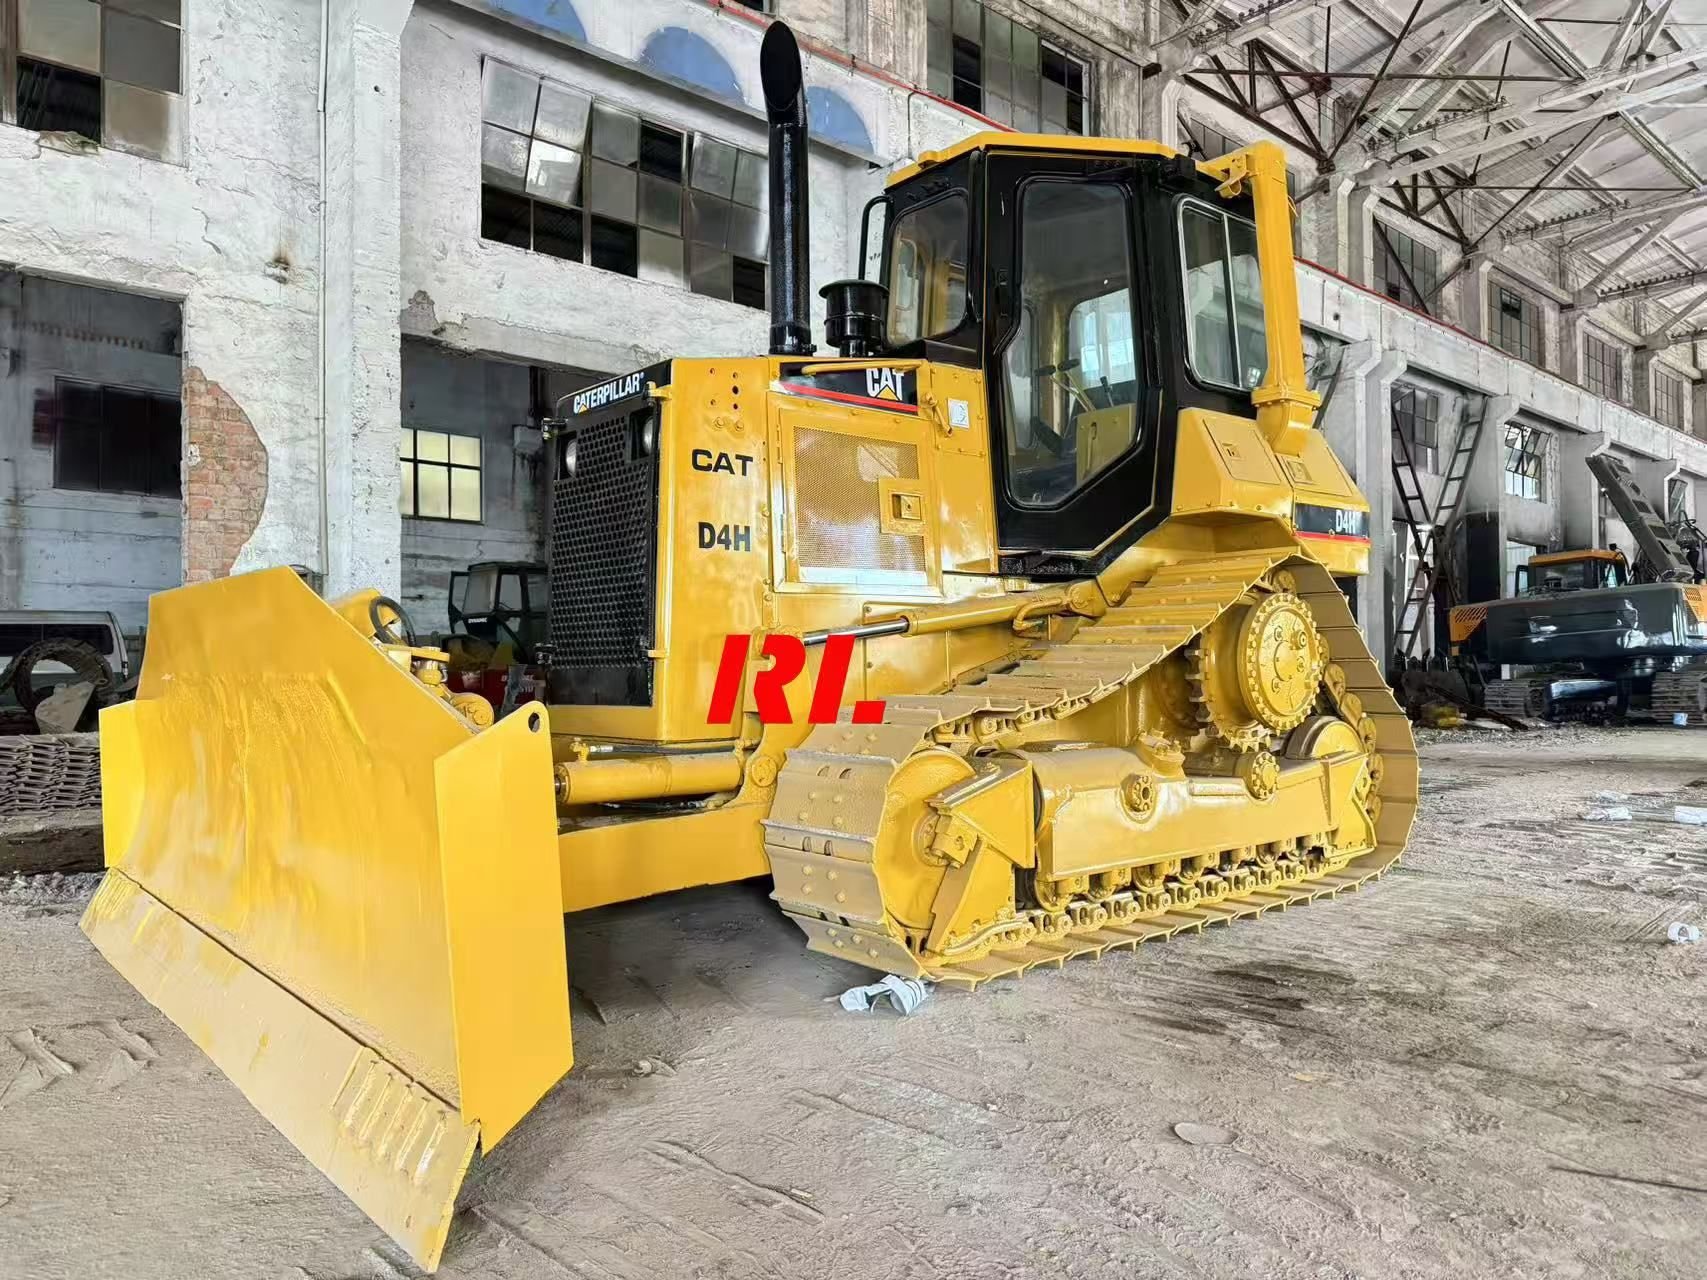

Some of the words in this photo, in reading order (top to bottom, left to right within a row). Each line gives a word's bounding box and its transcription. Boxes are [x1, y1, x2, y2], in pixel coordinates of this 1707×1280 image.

[573, 373, 641, 414] CATERPILLAR
[866, 367, 904, 401] CAT
[691, 448, 753, 477] CAT
[698, 521, 751, 552] D4H
[1335, 509, 1357, 535] D4H
